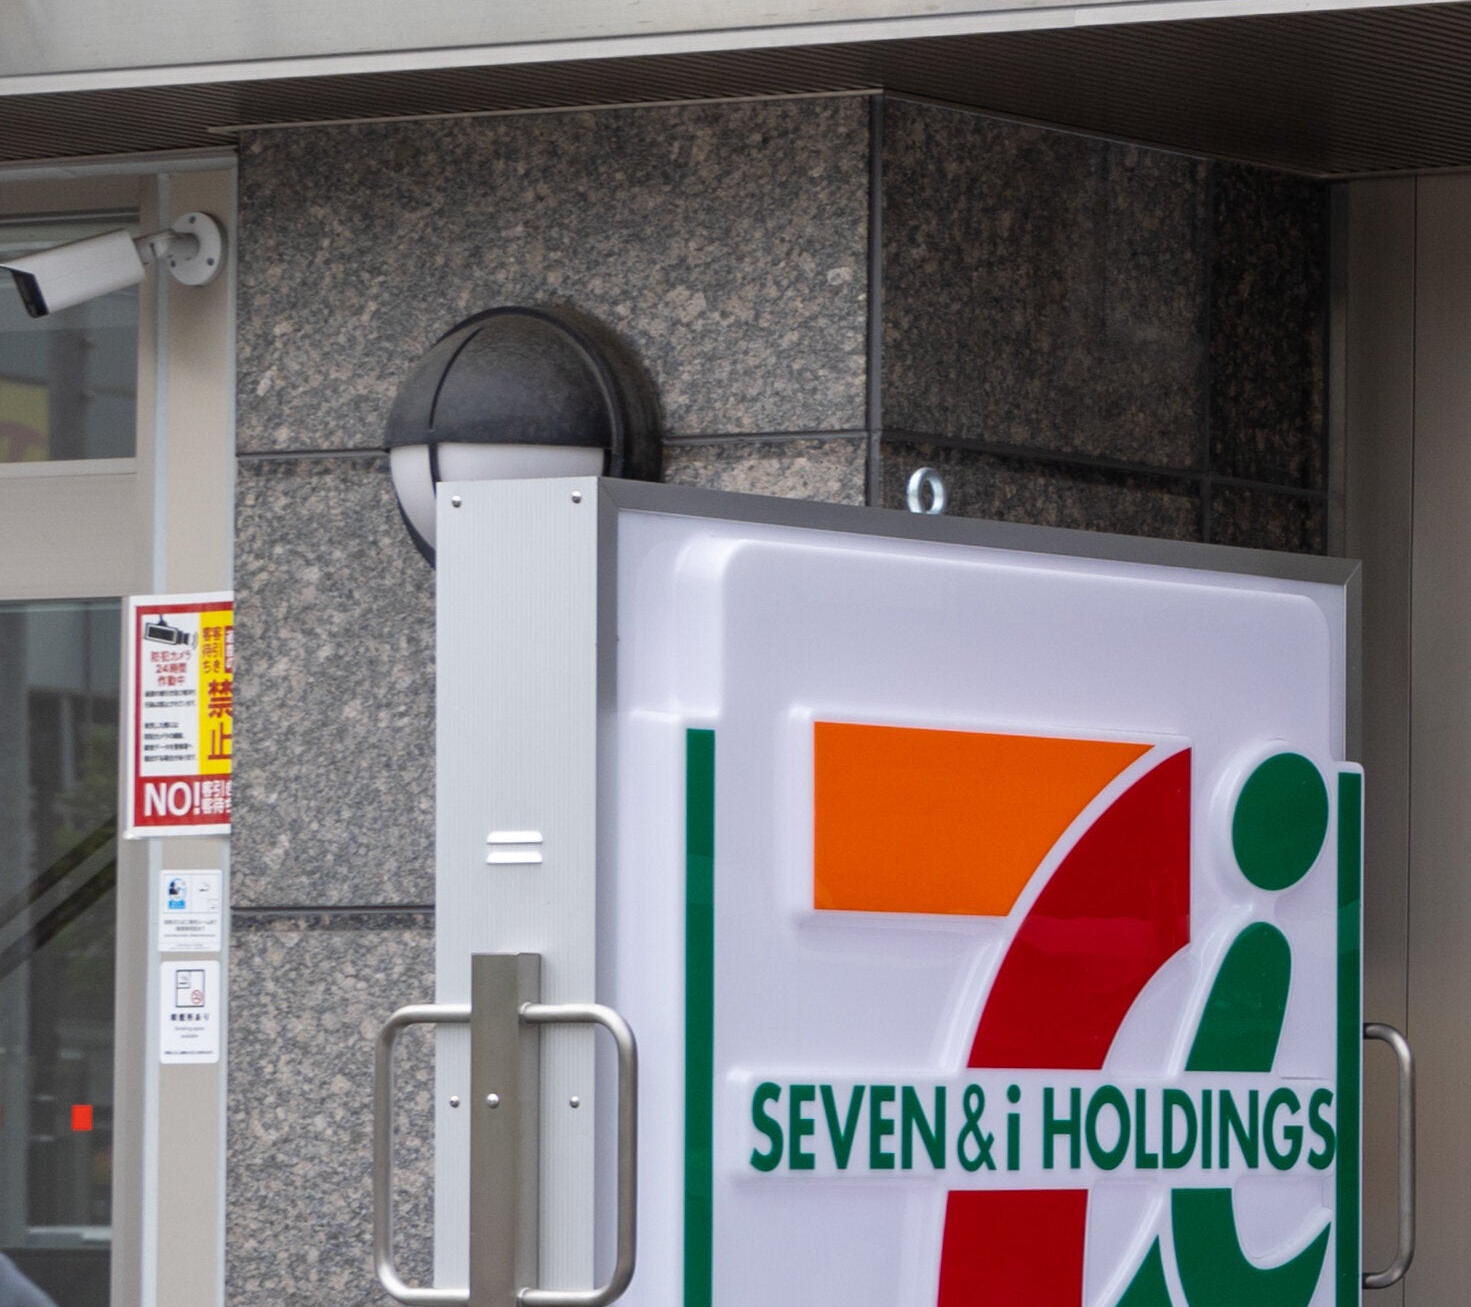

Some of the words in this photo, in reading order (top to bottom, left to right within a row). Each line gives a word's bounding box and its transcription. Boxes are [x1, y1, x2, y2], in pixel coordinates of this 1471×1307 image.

[144, 781, 200, 817] NO!
[749, 1082, 1021, 1173] SEVEN&i
[1043, 1087, 1336, 1173] HOLDINGS
